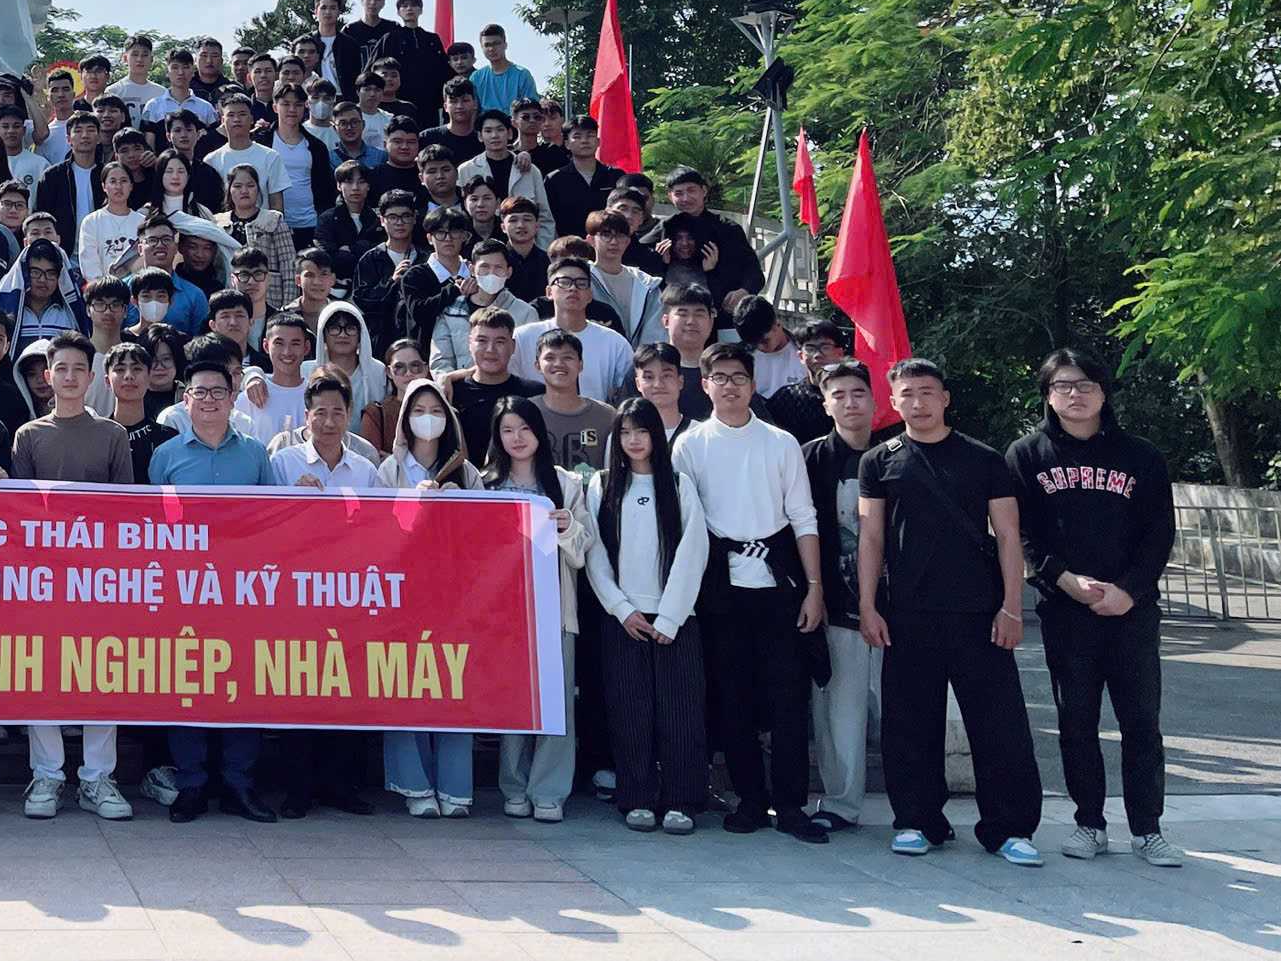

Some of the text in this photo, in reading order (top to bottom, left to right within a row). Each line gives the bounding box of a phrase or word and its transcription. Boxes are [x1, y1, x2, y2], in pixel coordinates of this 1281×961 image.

[1036, 466, 1136, 499] SUPREME
[21, 516, 104, 549] THÁI
[118, 517, 209, 551] BÌNH
[67, 561, 163, 611] NGHỆ
[177, 562, 223, 606] VÀ
[236, 564, 281, 606] KỸ
[292, 566, 405, 615] THUẬT
[61, 626, 238, 708] NGHIỆP,
[255, 628, 351, 698] NHÀ
[367, 630, 470, 700] MÁY
